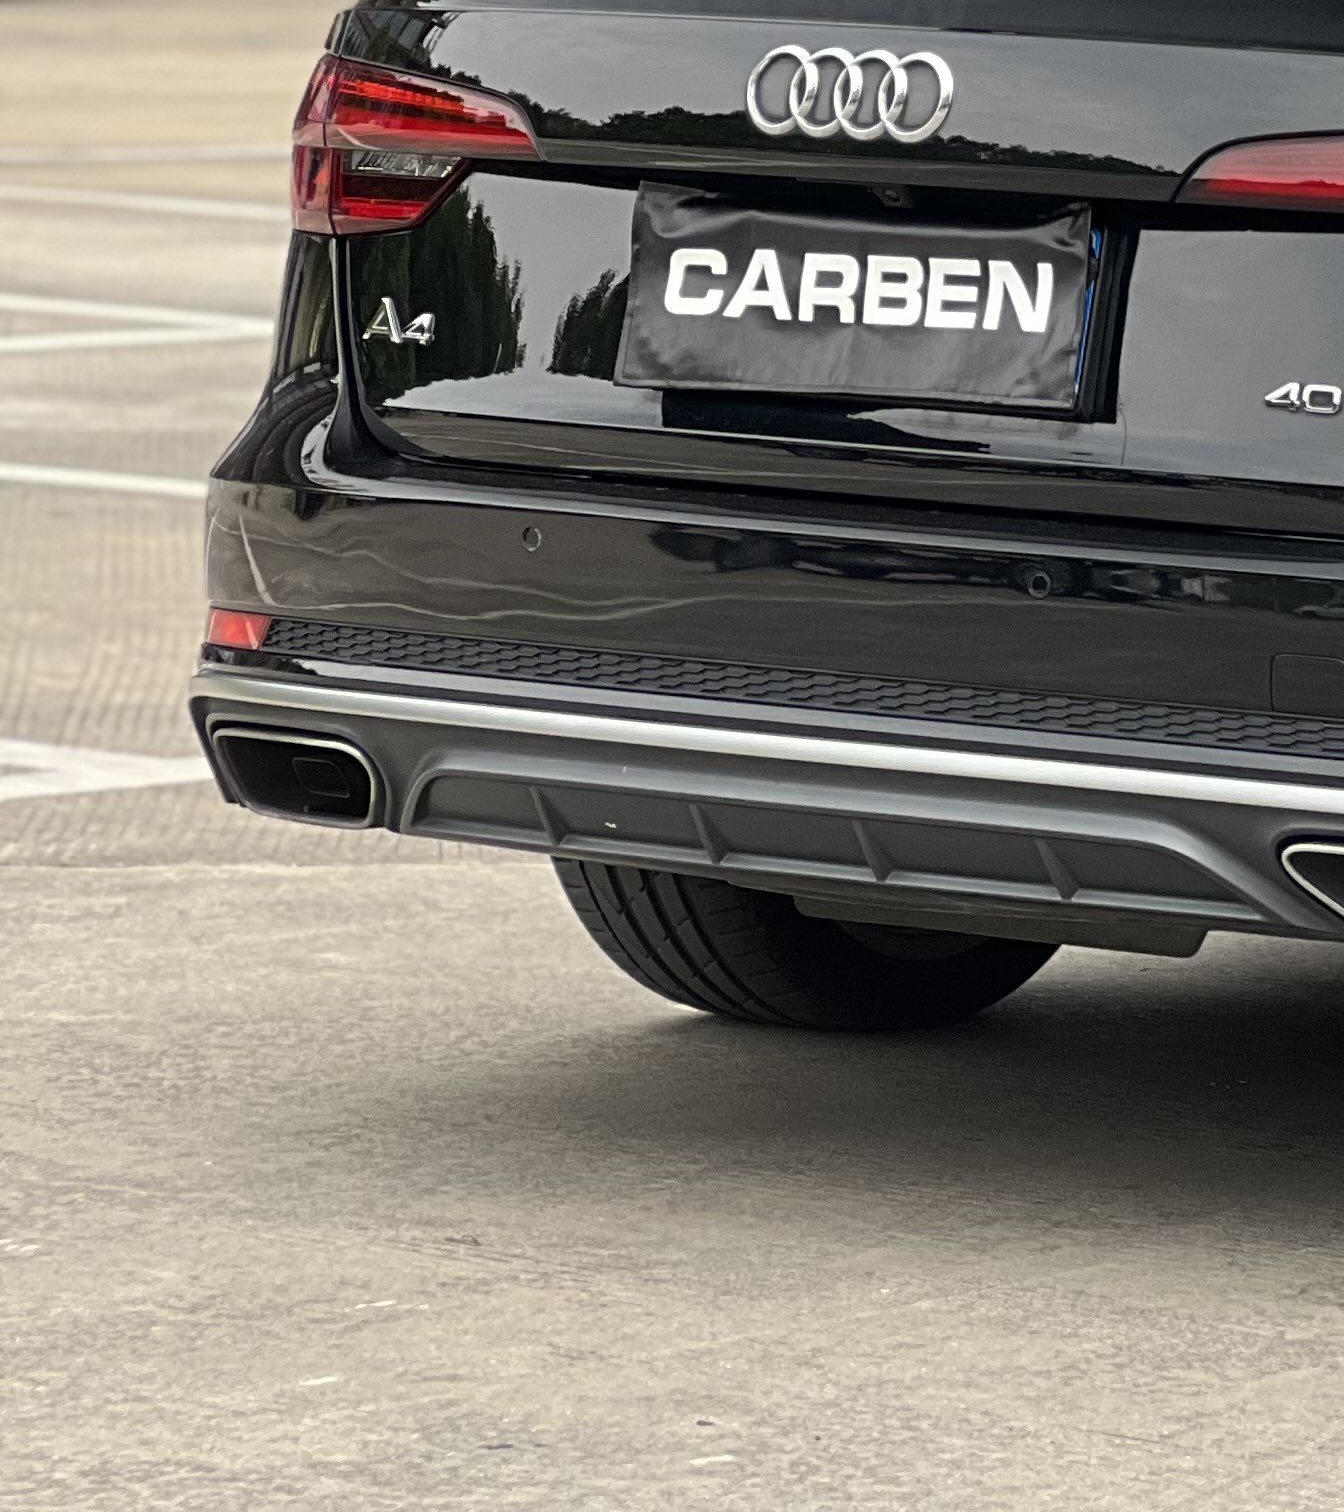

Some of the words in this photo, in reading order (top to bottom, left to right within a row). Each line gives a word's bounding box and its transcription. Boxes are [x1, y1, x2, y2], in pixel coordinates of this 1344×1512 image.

[664, 248, 1054, 333] CARBEN
[362, 296, 435, 345] A4
[1264, 382, 1342, 415] 40
